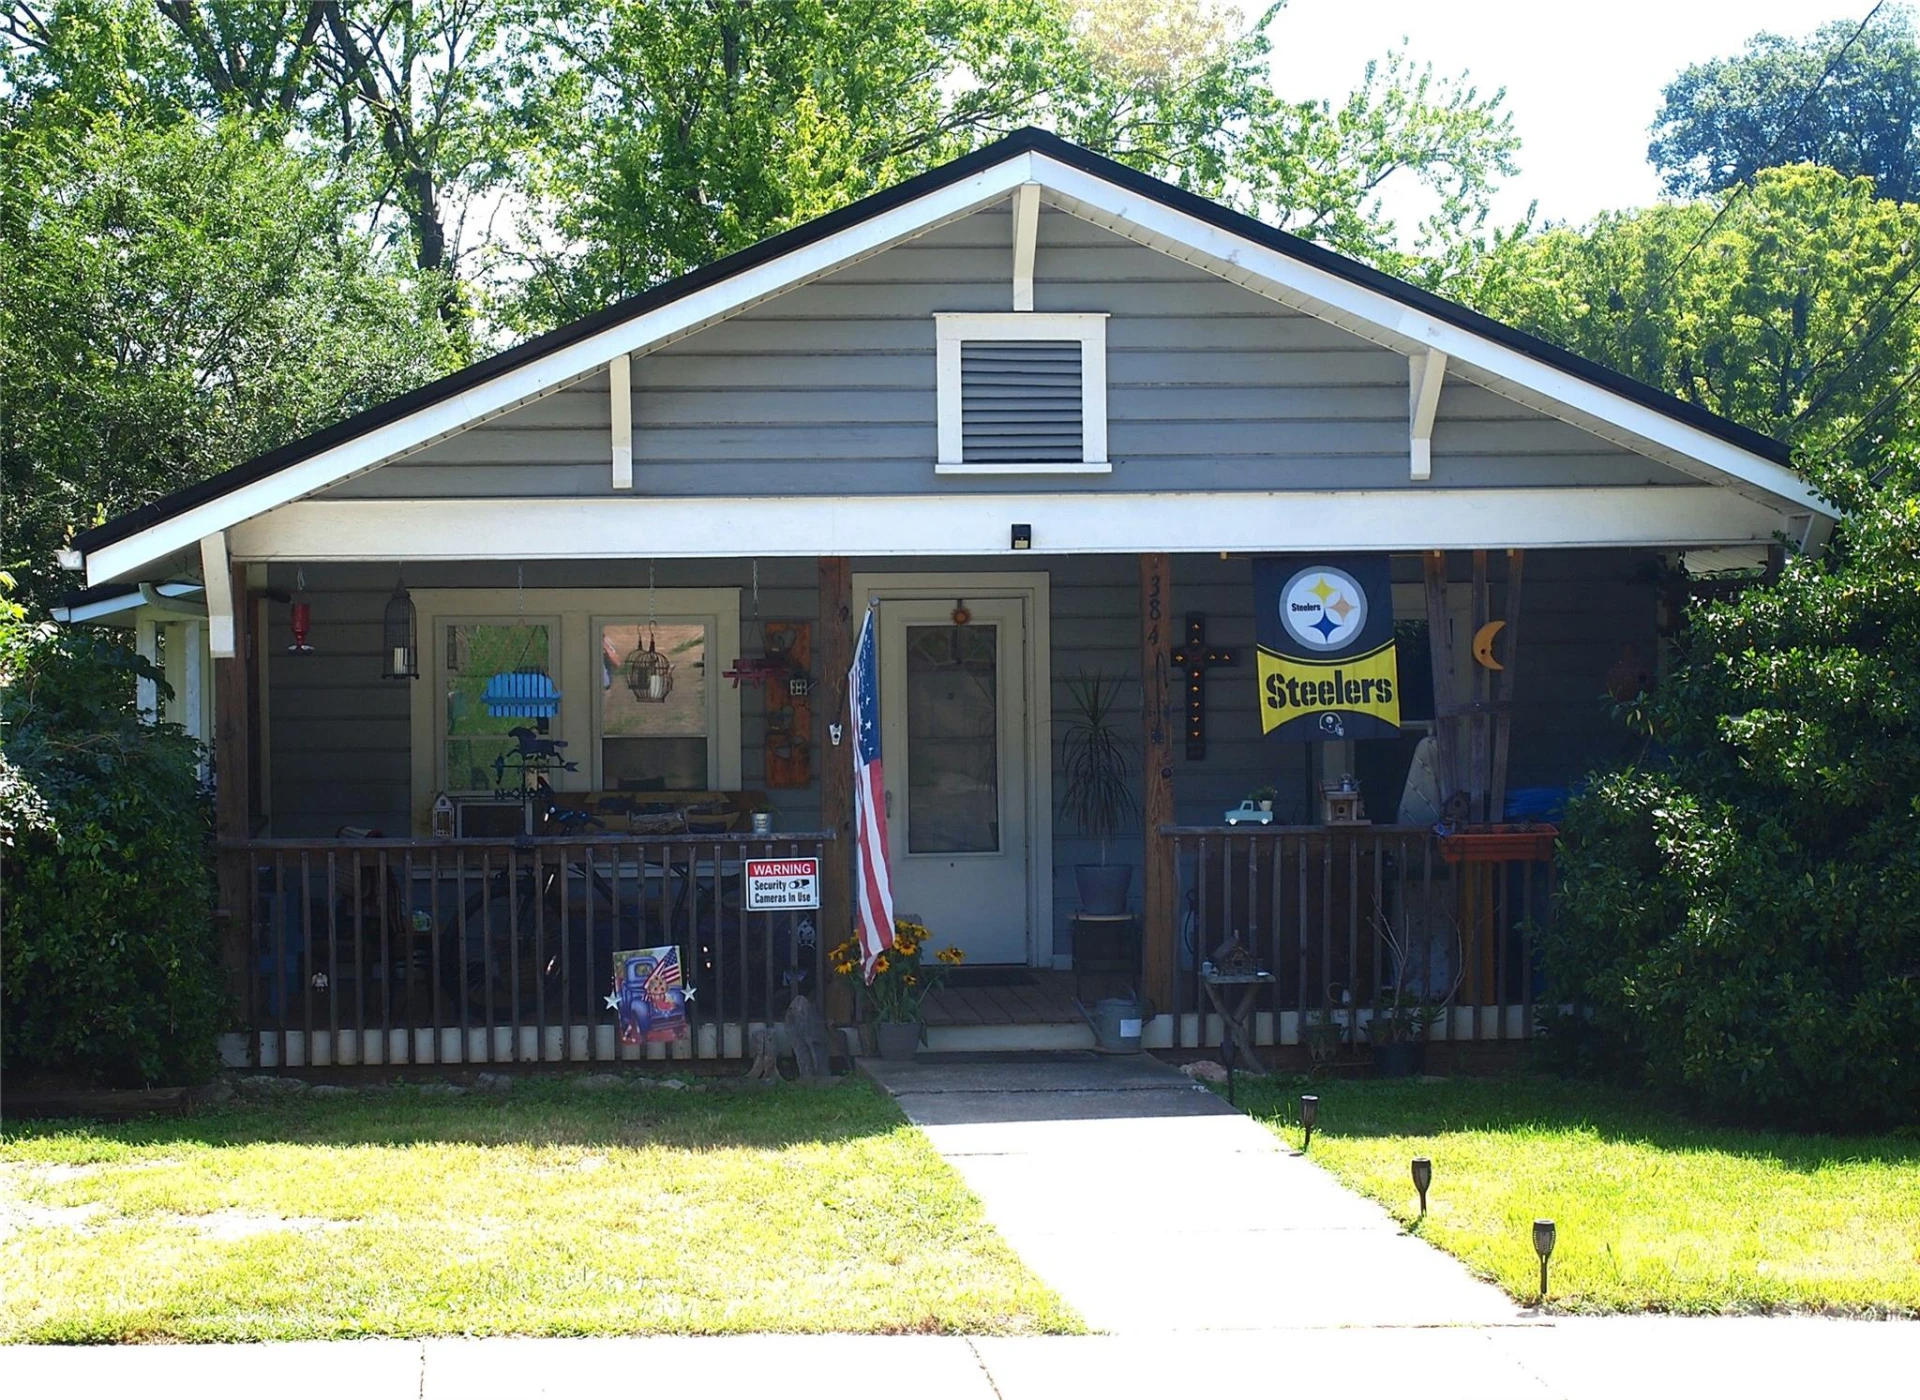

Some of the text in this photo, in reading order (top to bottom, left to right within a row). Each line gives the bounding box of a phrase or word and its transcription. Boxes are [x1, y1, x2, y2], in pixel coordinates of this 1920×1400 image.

[1291, 602, 1321, 612] Steelers
[1266, 669, 1393, 709] Steelers
[753, 864, 811, 876] WARNING
[754, 879, 787, 892] Security
[754, 892, 811, 903] Cameras In Use
